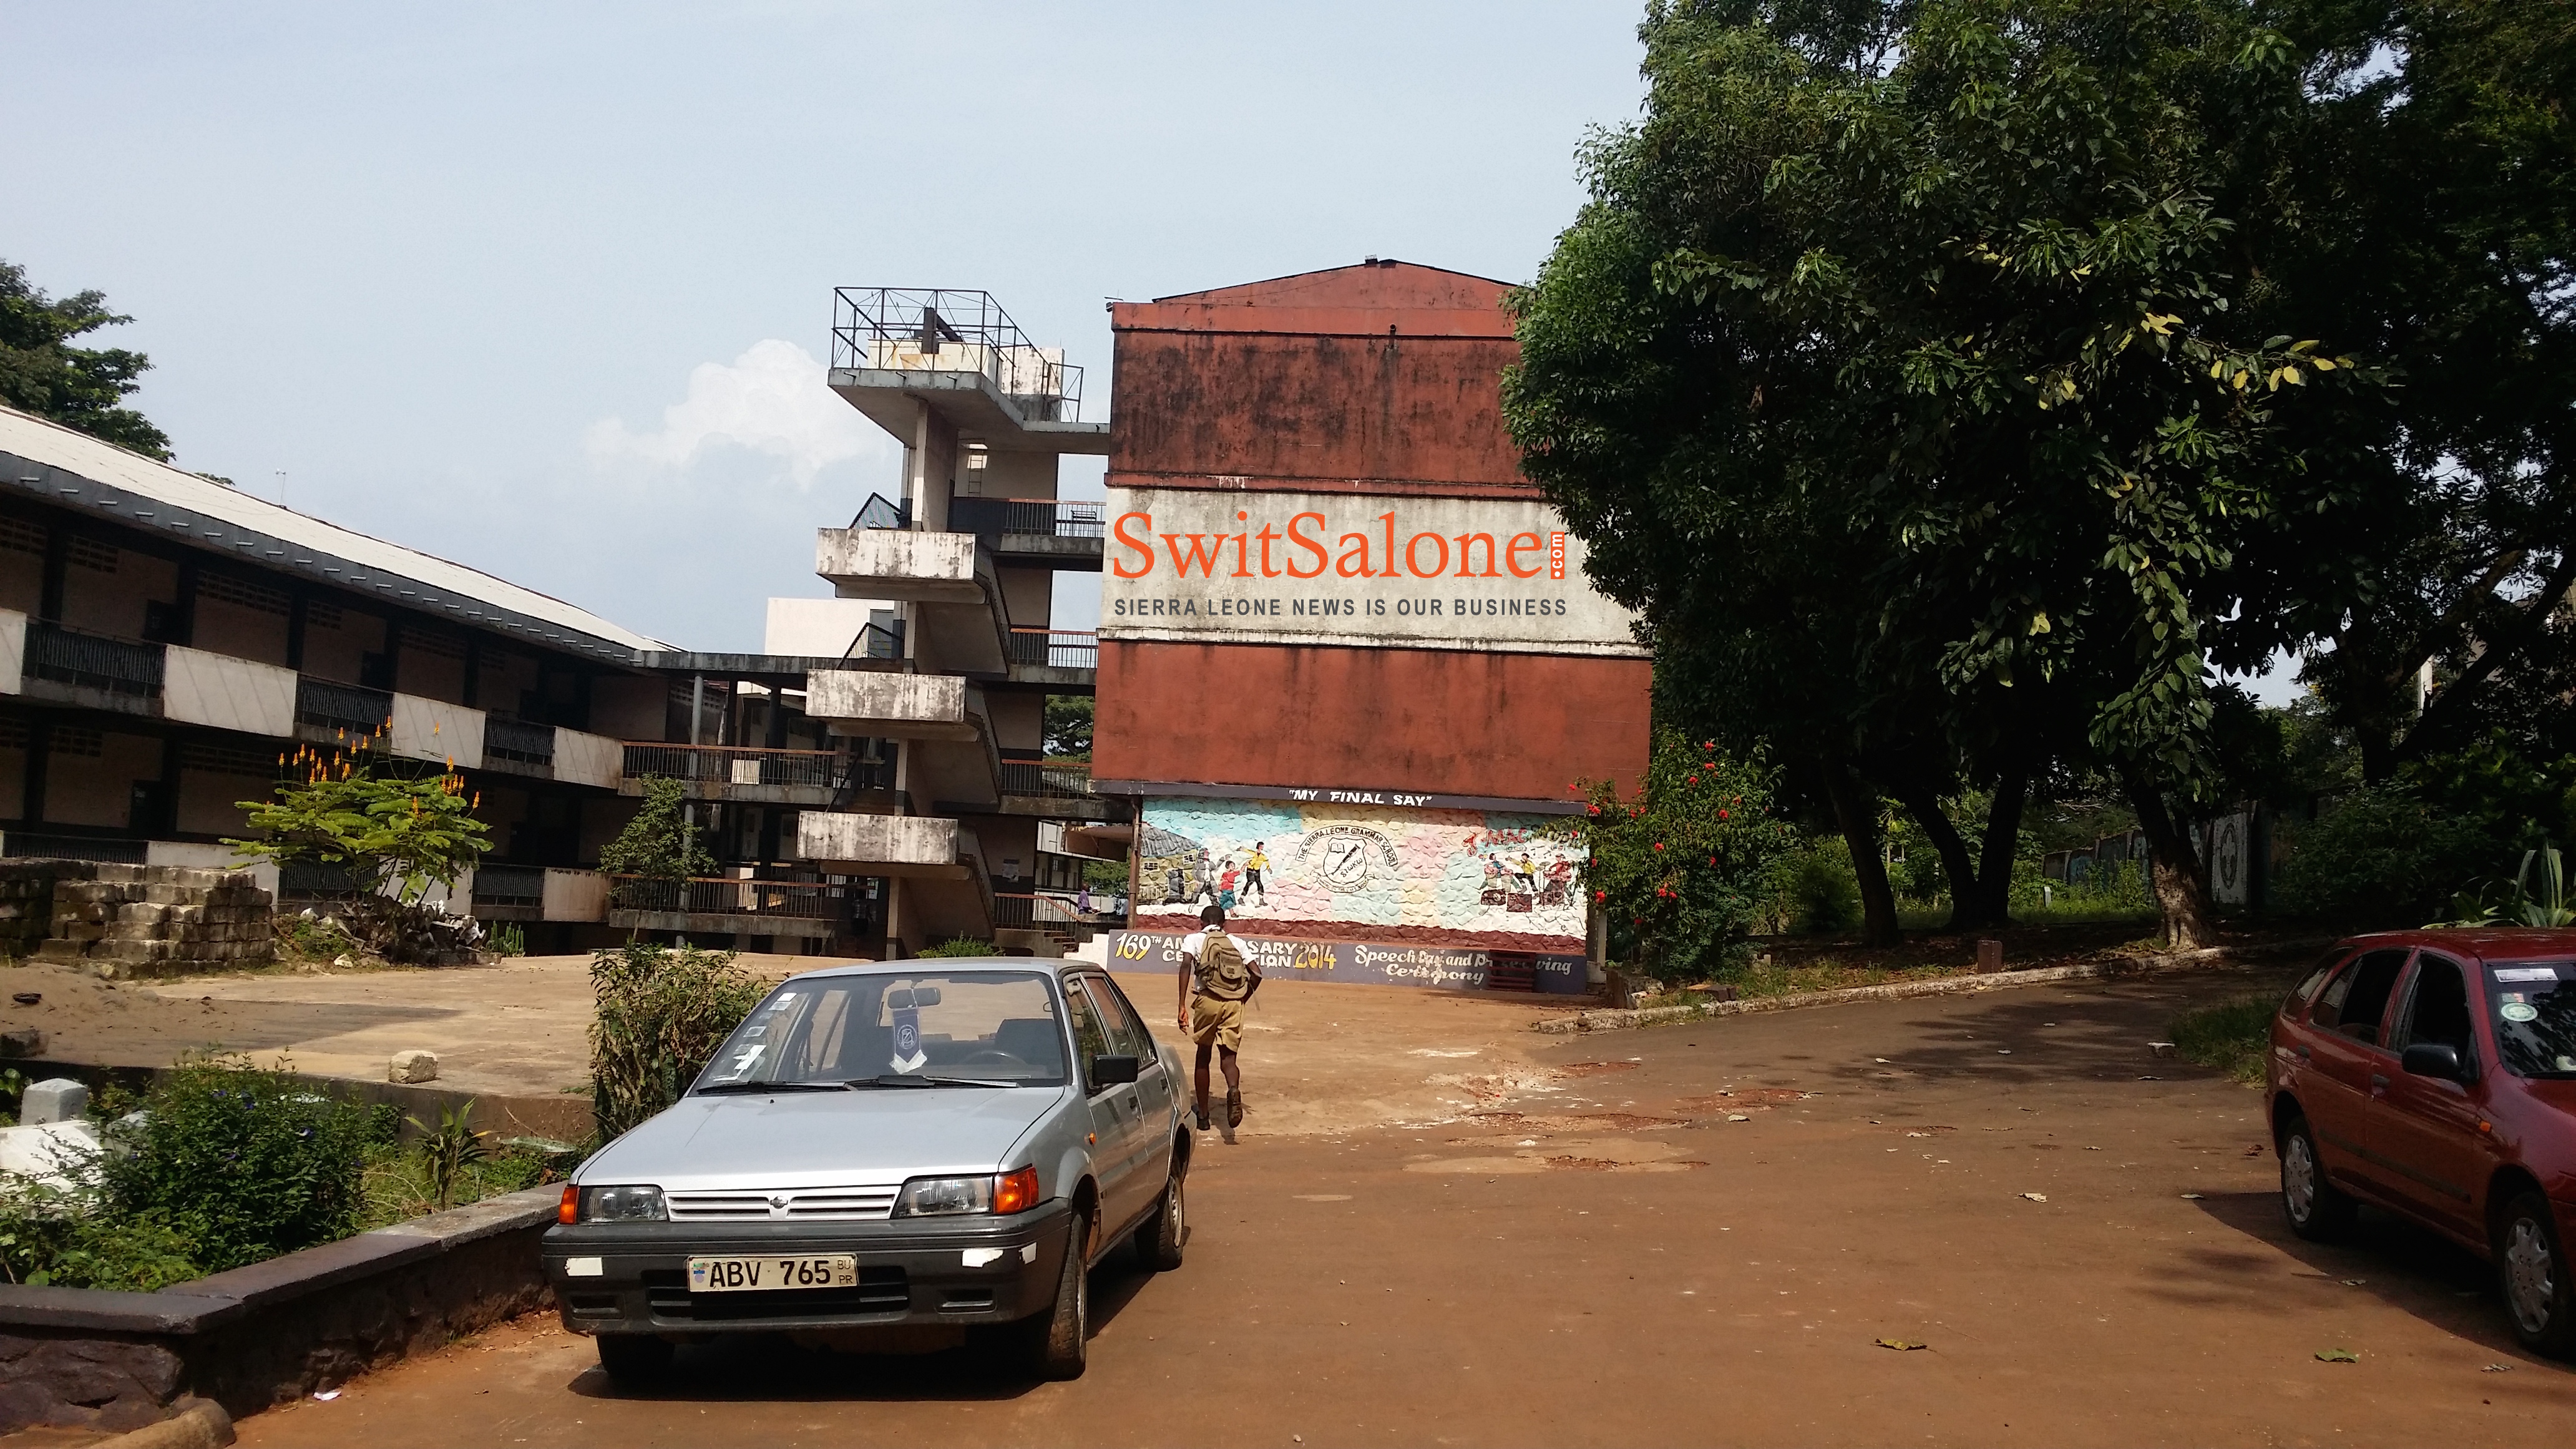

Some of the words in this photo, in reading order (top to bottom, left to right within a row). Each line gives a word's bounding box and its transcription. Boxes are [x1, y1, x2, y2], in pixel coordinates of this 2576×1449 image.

[1330, 791, 1385, 804] FINAL
[1298, 847, 1308, 859] THE
[1304, 830, 1324, 846] SIERRA
[1324, 827, 1349, 835] LEONE
[1350, 827, 1383, 844] GRAMMAR
[1381, 841, 1397, 867] SCHOOL
[1294, 943, 1337, 970] 2014
[1355, 944, 1416, 967] Speech
[1445, 953, 1473, 966] and
[710, 1261, 761, 1287] ABV
[780, 1260, 831, 1286] 765
[837, 1259, 851, 1269] BU
[839, 1275, 852, 1284] PR
